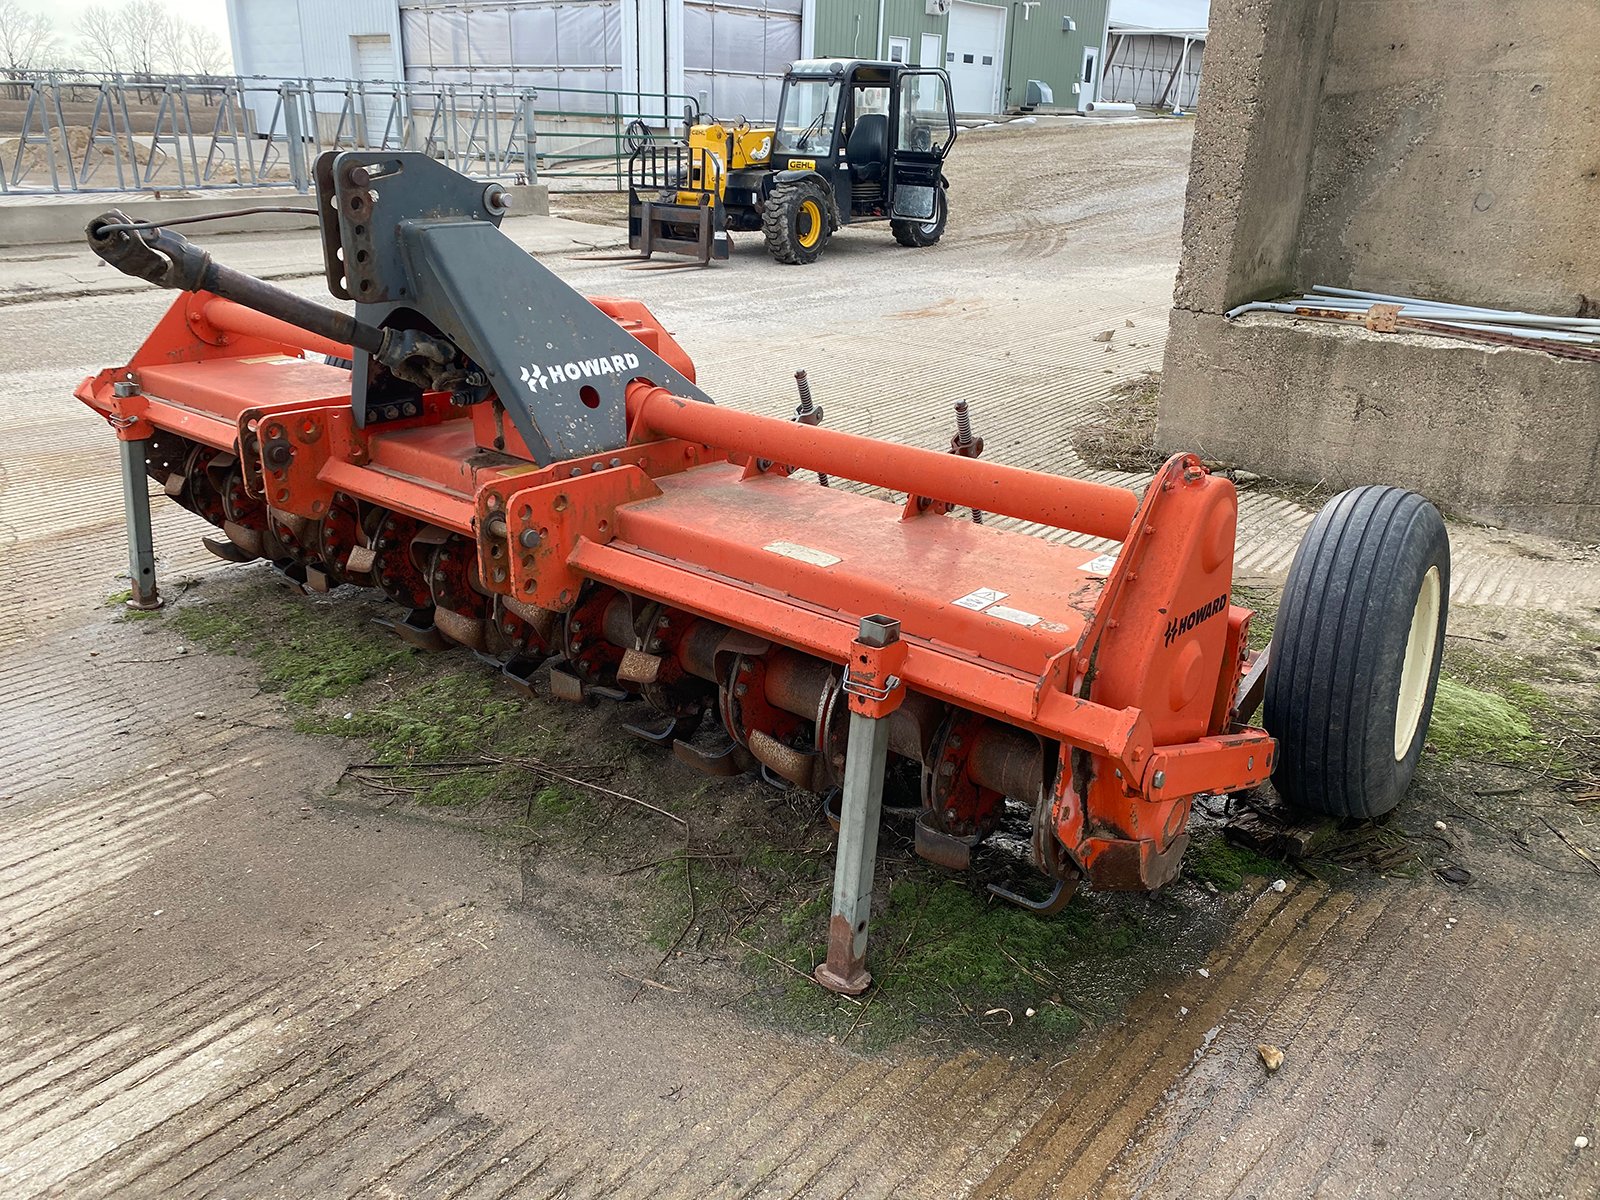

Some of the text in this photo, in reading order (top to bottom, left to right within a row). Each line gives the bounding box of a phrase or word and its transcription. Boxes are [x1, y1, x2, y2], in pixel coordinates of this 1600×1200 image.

[789, 161, 813, 169] GEHL
[546, 352, 640, 384] HOWARD
[1178, 593, 1227, 636] HOWARD
